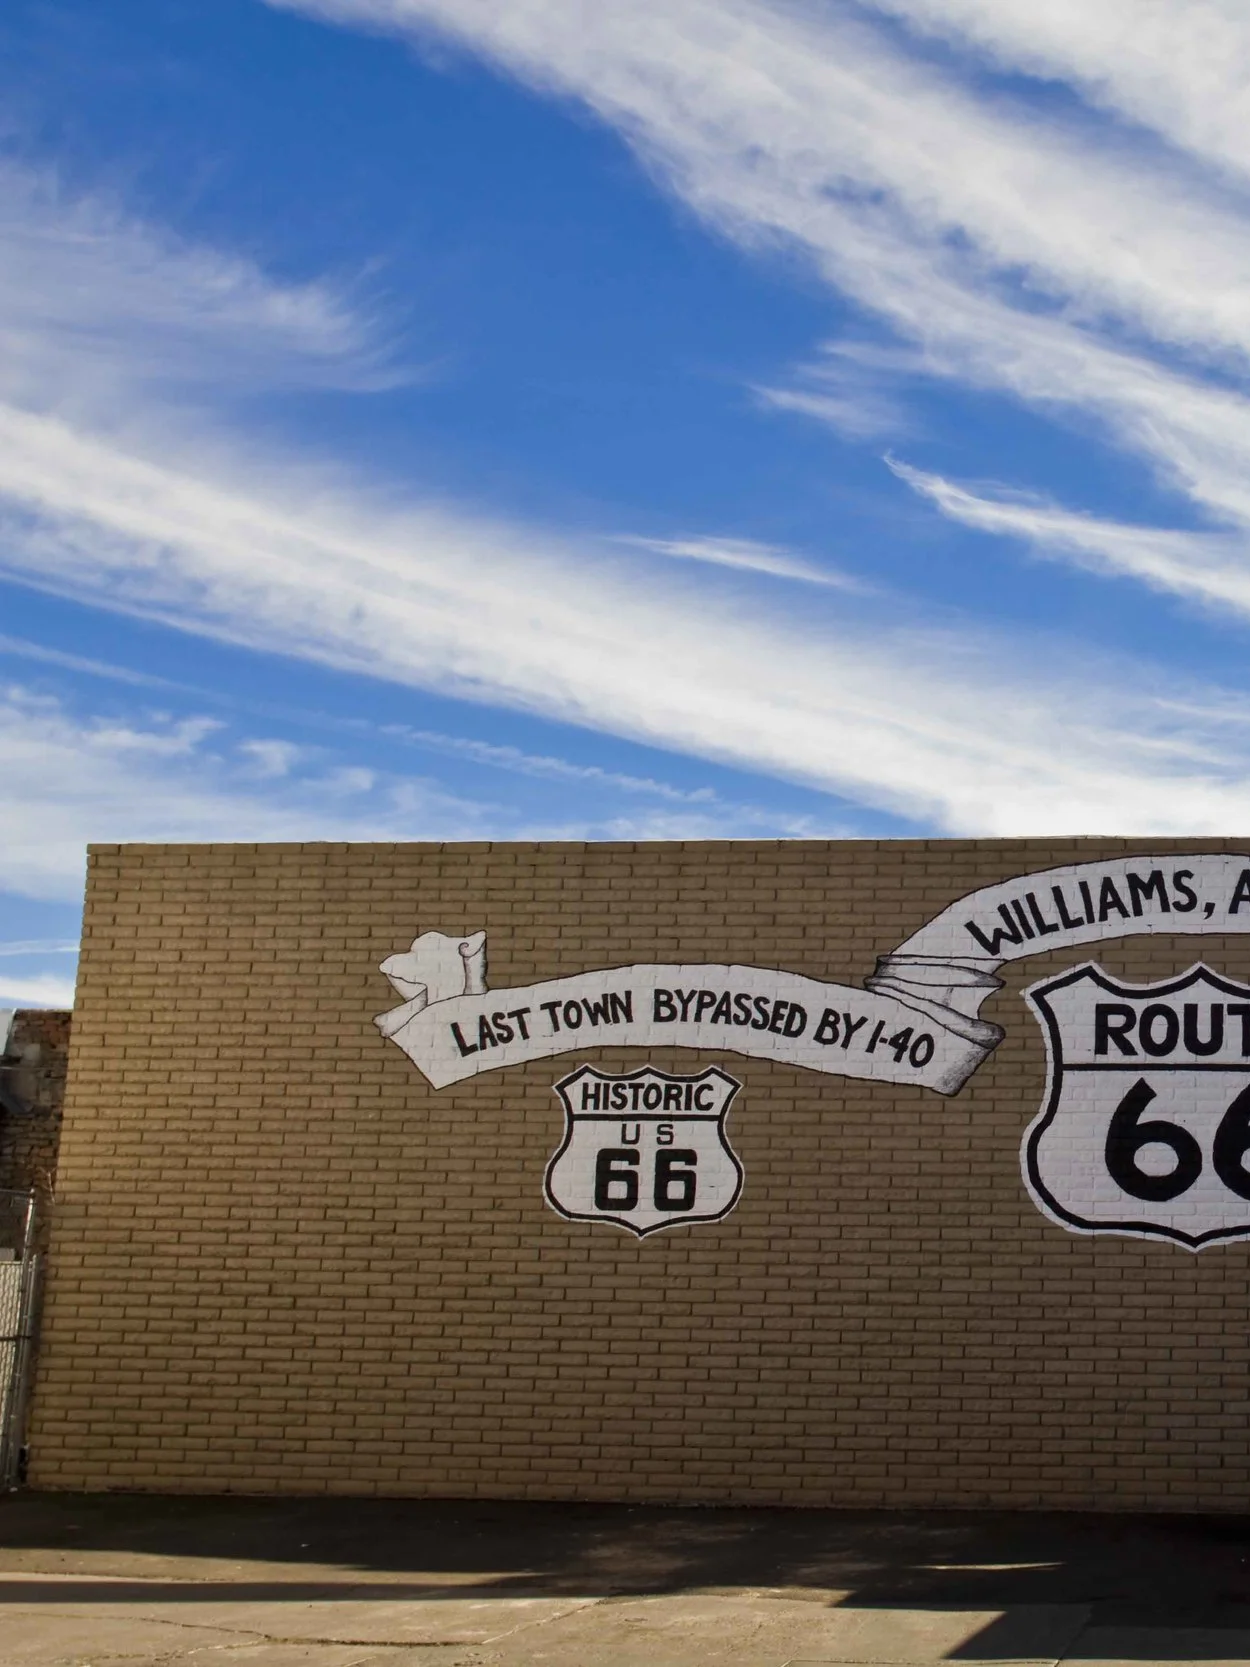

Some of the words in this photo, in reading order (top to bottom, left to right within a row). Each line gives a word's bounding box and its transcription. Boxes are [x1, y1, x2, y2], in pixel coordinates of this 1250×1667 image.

[965, 868, 1216, 956] WILLIAMS,
[451, 1008, 529, 1057] LAST
[541, 990, 633, 1032] TOWN
[653, 988, 807, 1038] BYPASSED
[815, 1003, 869, 1050] BY
[866, 1018, 935, 1067] I-40
[580, 1082, 714, 1112] HISTORIC
[594, 1148, 698, 1212] 66
